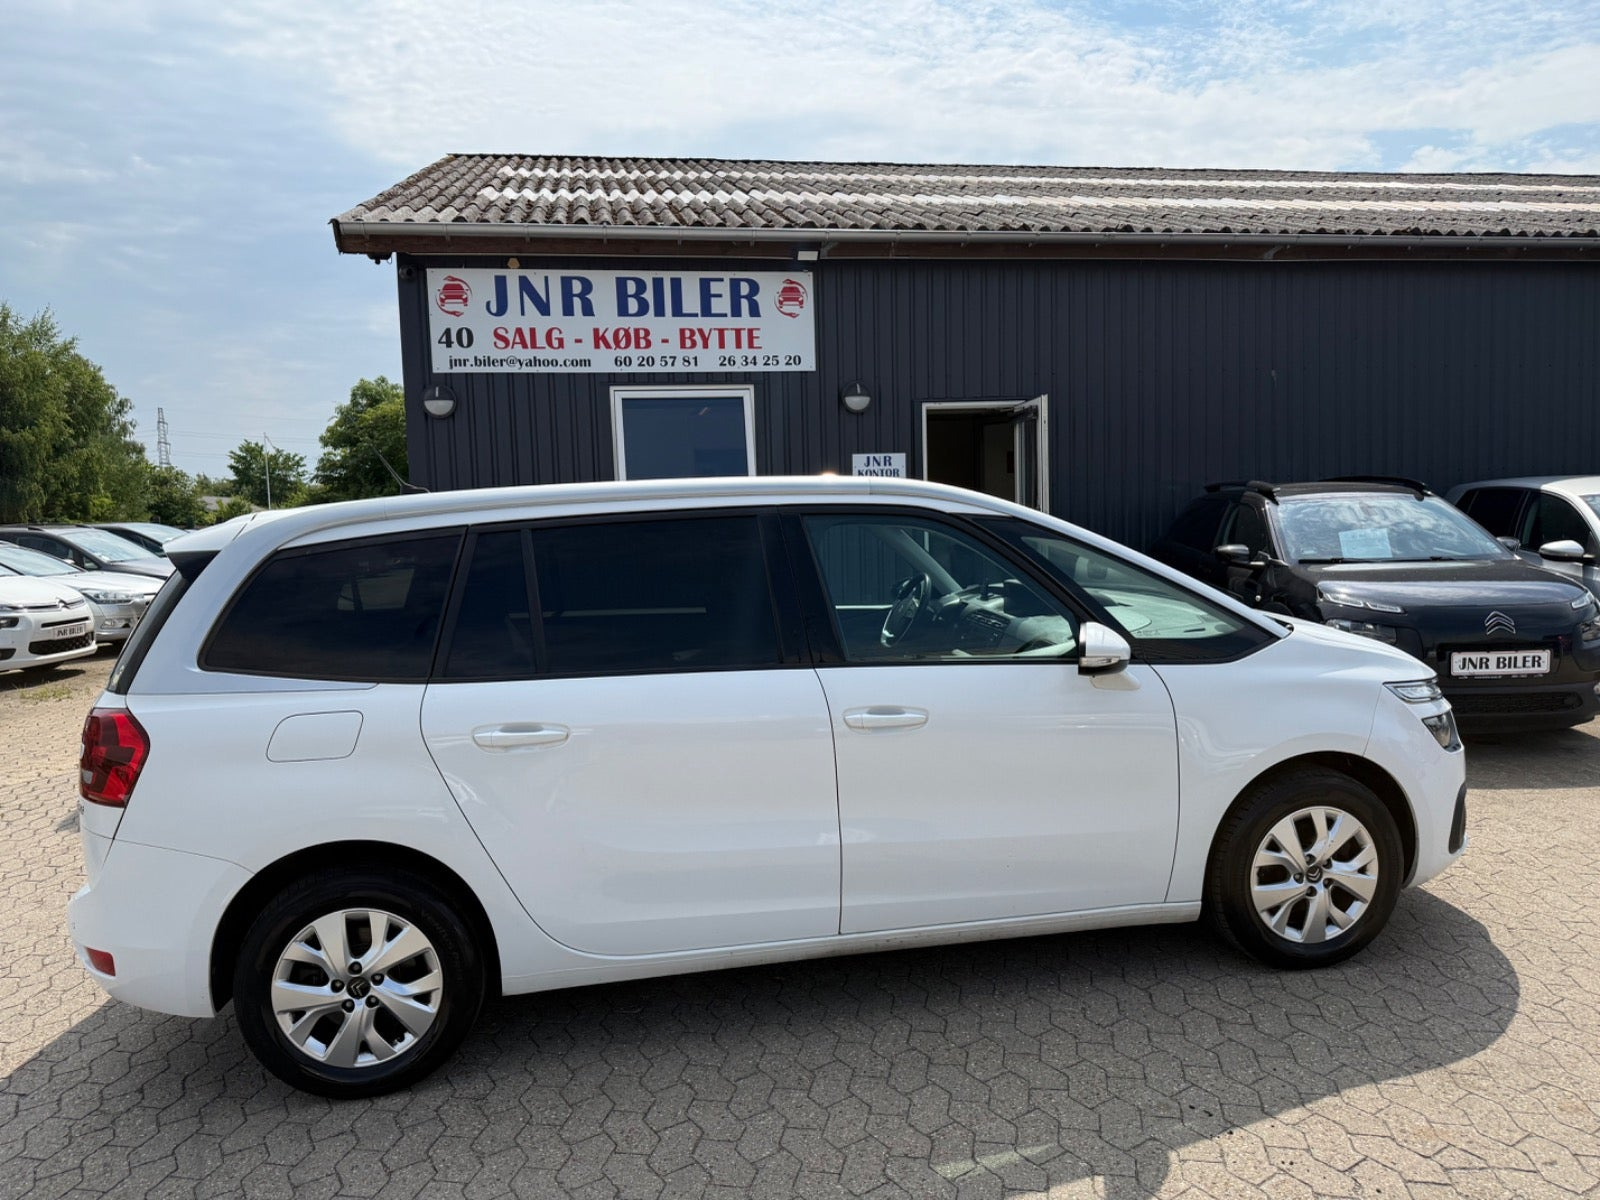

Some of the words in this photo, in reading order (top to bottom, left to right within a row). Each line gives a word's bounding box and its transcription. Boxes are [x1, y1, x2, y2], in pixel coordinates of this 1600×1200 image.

[485, 275, 595, 317] JNR
[615, 276, 761, 318] BILER
[438, 327, 474, 349] 40
[493, 327, 565, 350] SALG
[593, 326, 651, 351] KØB
[679, 327, 763, 350] BYTTE
[449, 355, 592, 370] jnr.biler@yahoo.com
[614, 356, 632, 367] 60
[637, 356, 655, 367] 20
[659, 356, 677, 367] 57
[682, 356, 699, 367] 81
[719, 355, 736, 367] 26
[740, 355, 758, 367] 34
[762, 355, 780, 366] 25
[784, 354, 802, 366] 20
[864, 455, 892, 468] JNR
[857, 468, 900, 478] KONTOR
[1459, 656, 1490, 671] JNR
[1496, 655, 1542, 670] BILER
